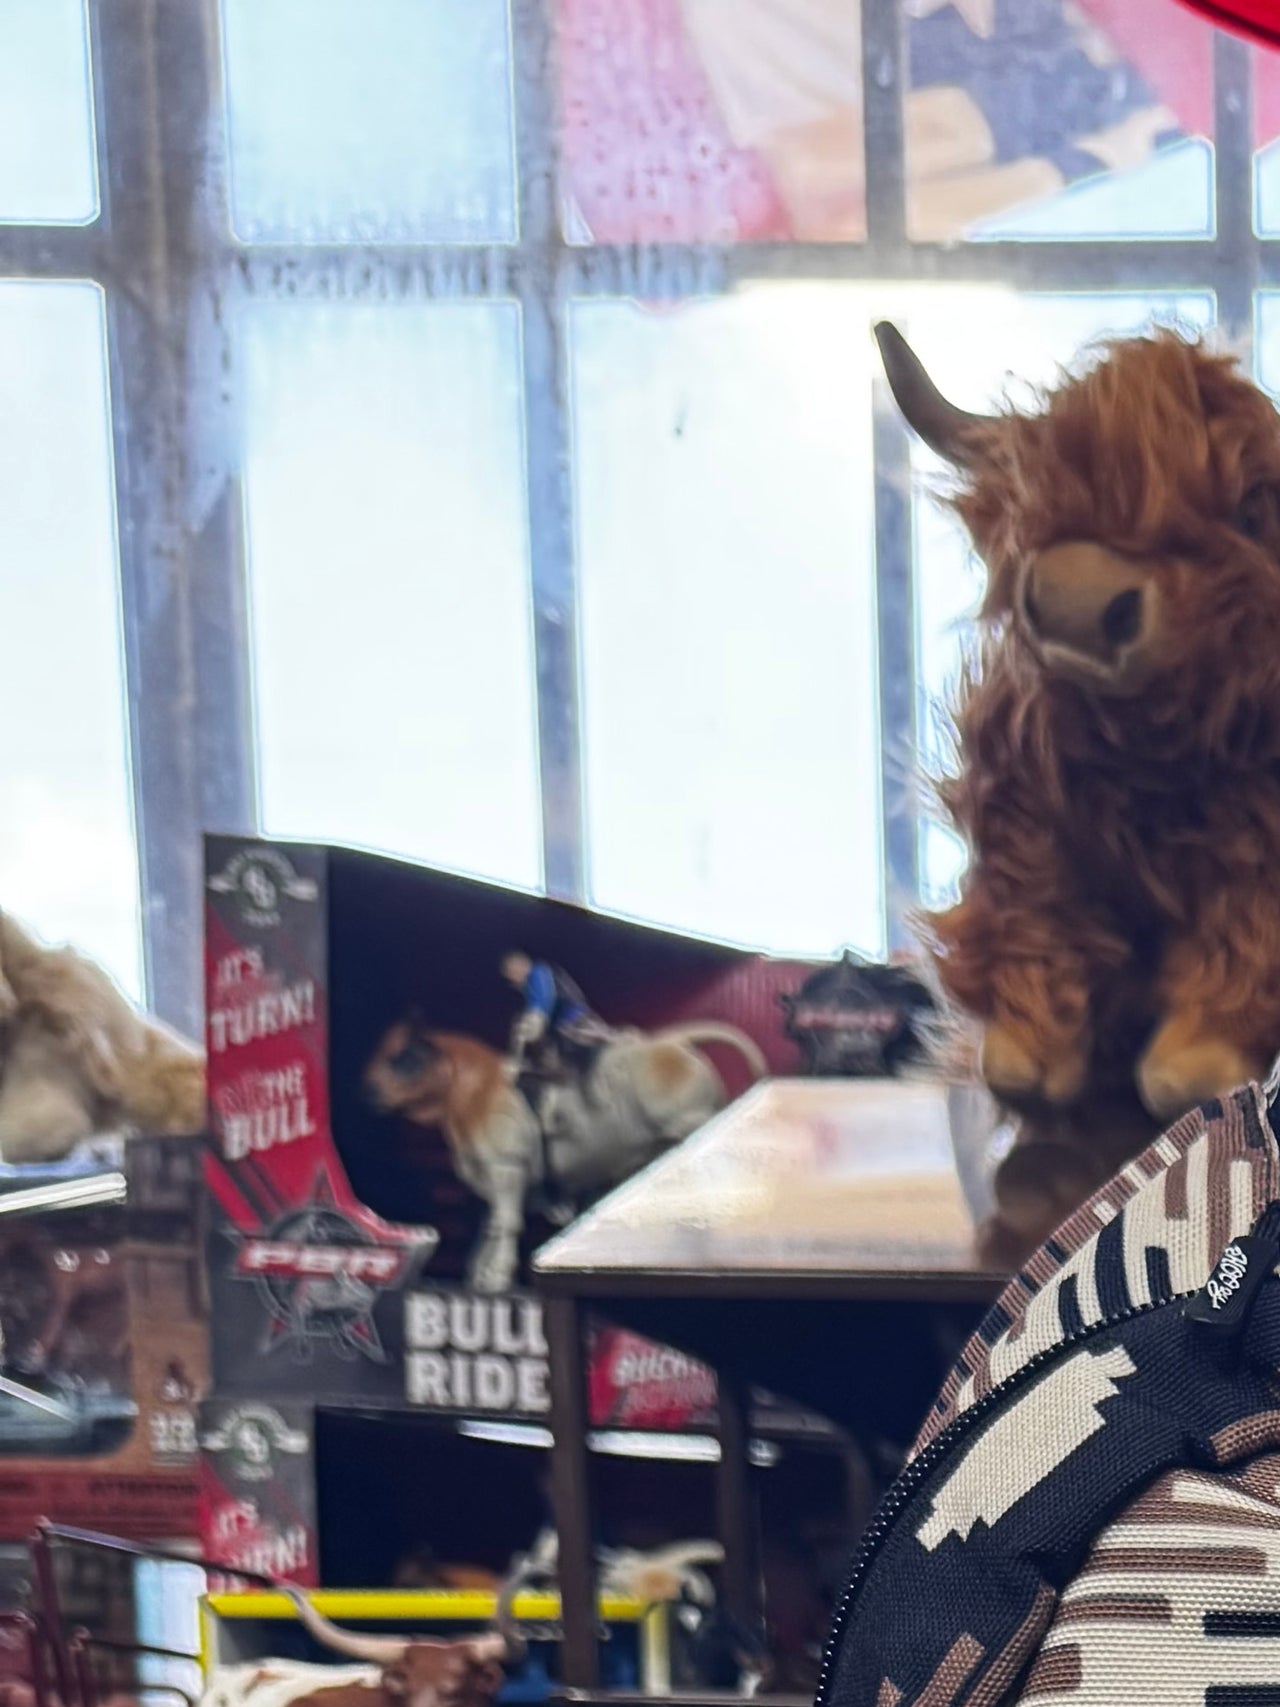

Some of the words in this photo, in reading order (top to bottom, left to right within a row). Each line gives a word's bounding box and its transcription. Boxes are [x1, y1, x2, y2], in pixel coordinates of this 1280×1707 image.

[210, 979, 315, 1051] TURN!
[223, 1098, 317, 1160] BULL
[410, 1299, 550, 1355] BULL
[409, 1351, 552, 1410] RIDE
